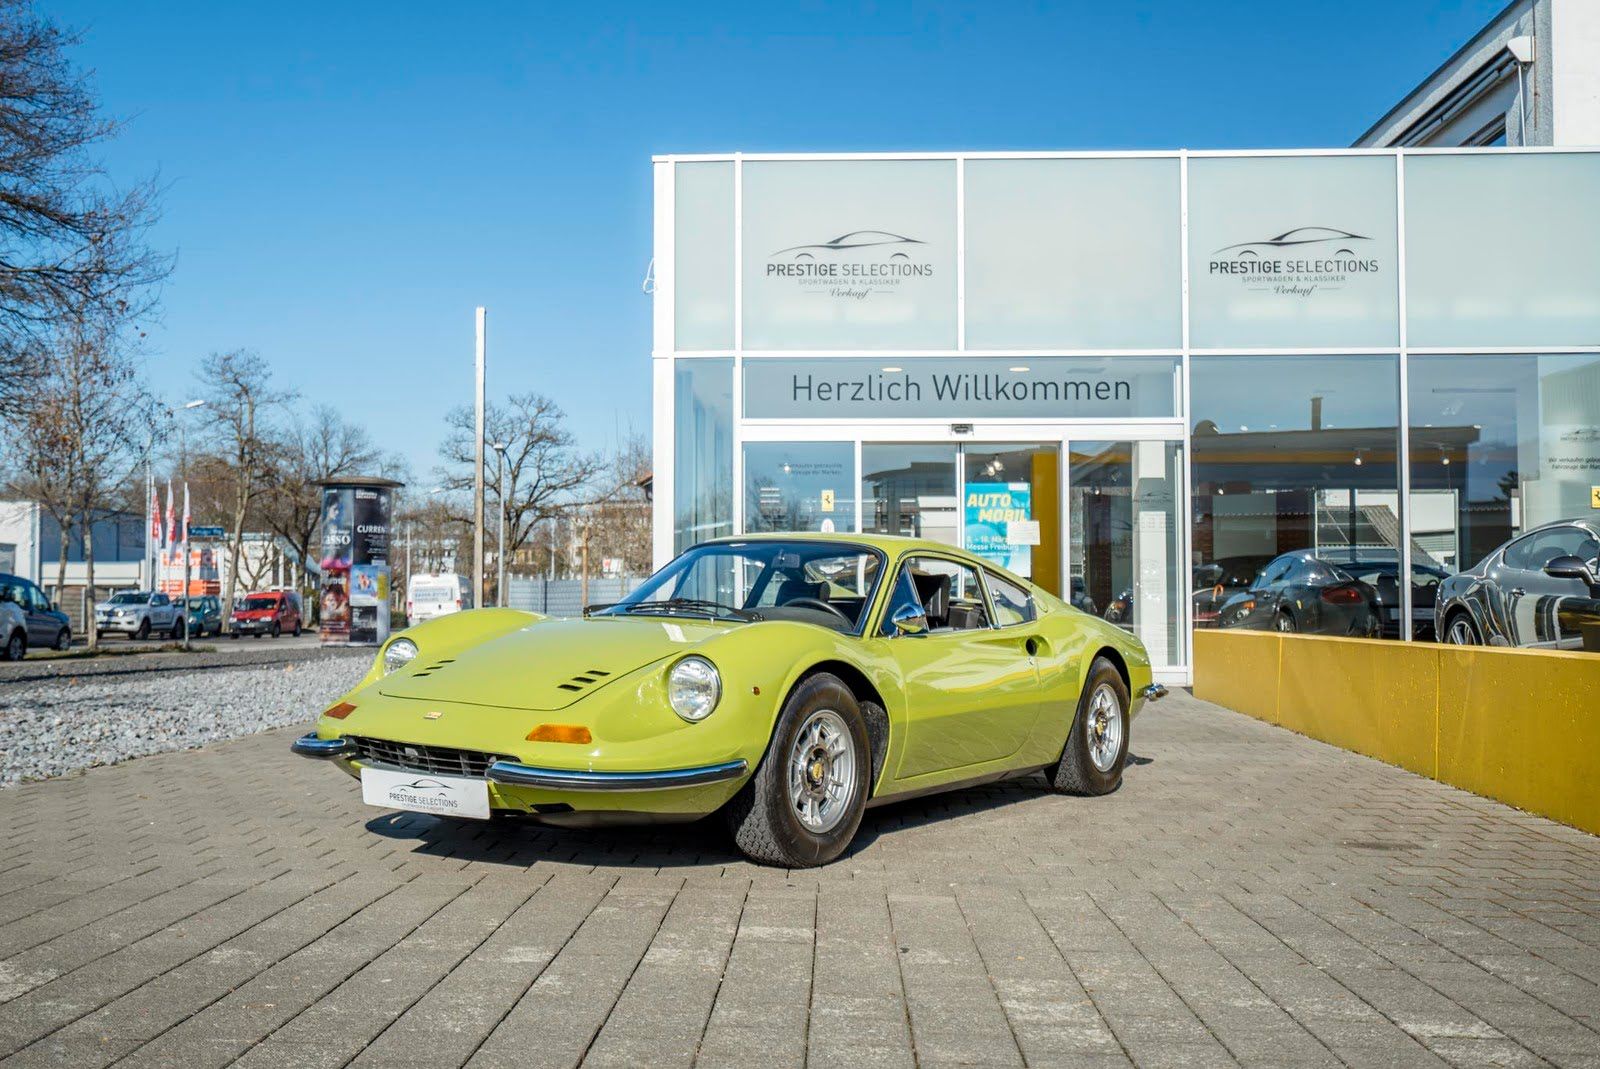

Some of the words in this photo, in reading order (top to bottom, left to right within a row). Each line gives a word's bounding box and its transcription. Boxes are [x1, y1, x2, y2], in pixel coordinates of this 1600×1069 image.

[767, 263, 838, 277] PRESTIGE
[842, 263, 933, 277] SELECTIONS
[1209, 261, 1282, 275] PRESTIGE
[1286, 259, 1379, 273] SELECTIONS
[1304, 275, 1346, 283] KLASSIKER
[793, 374, 921, 401] Herzlich
[932, 373, 1131, 401] Willkommen
[967, 493, 1011, 508] AUTO
[979, 508, 1026, 523] MOBIL
[389, 792, 418, 804] PRESTIGE
[418, 796, 458, 808] SELECTIONS
